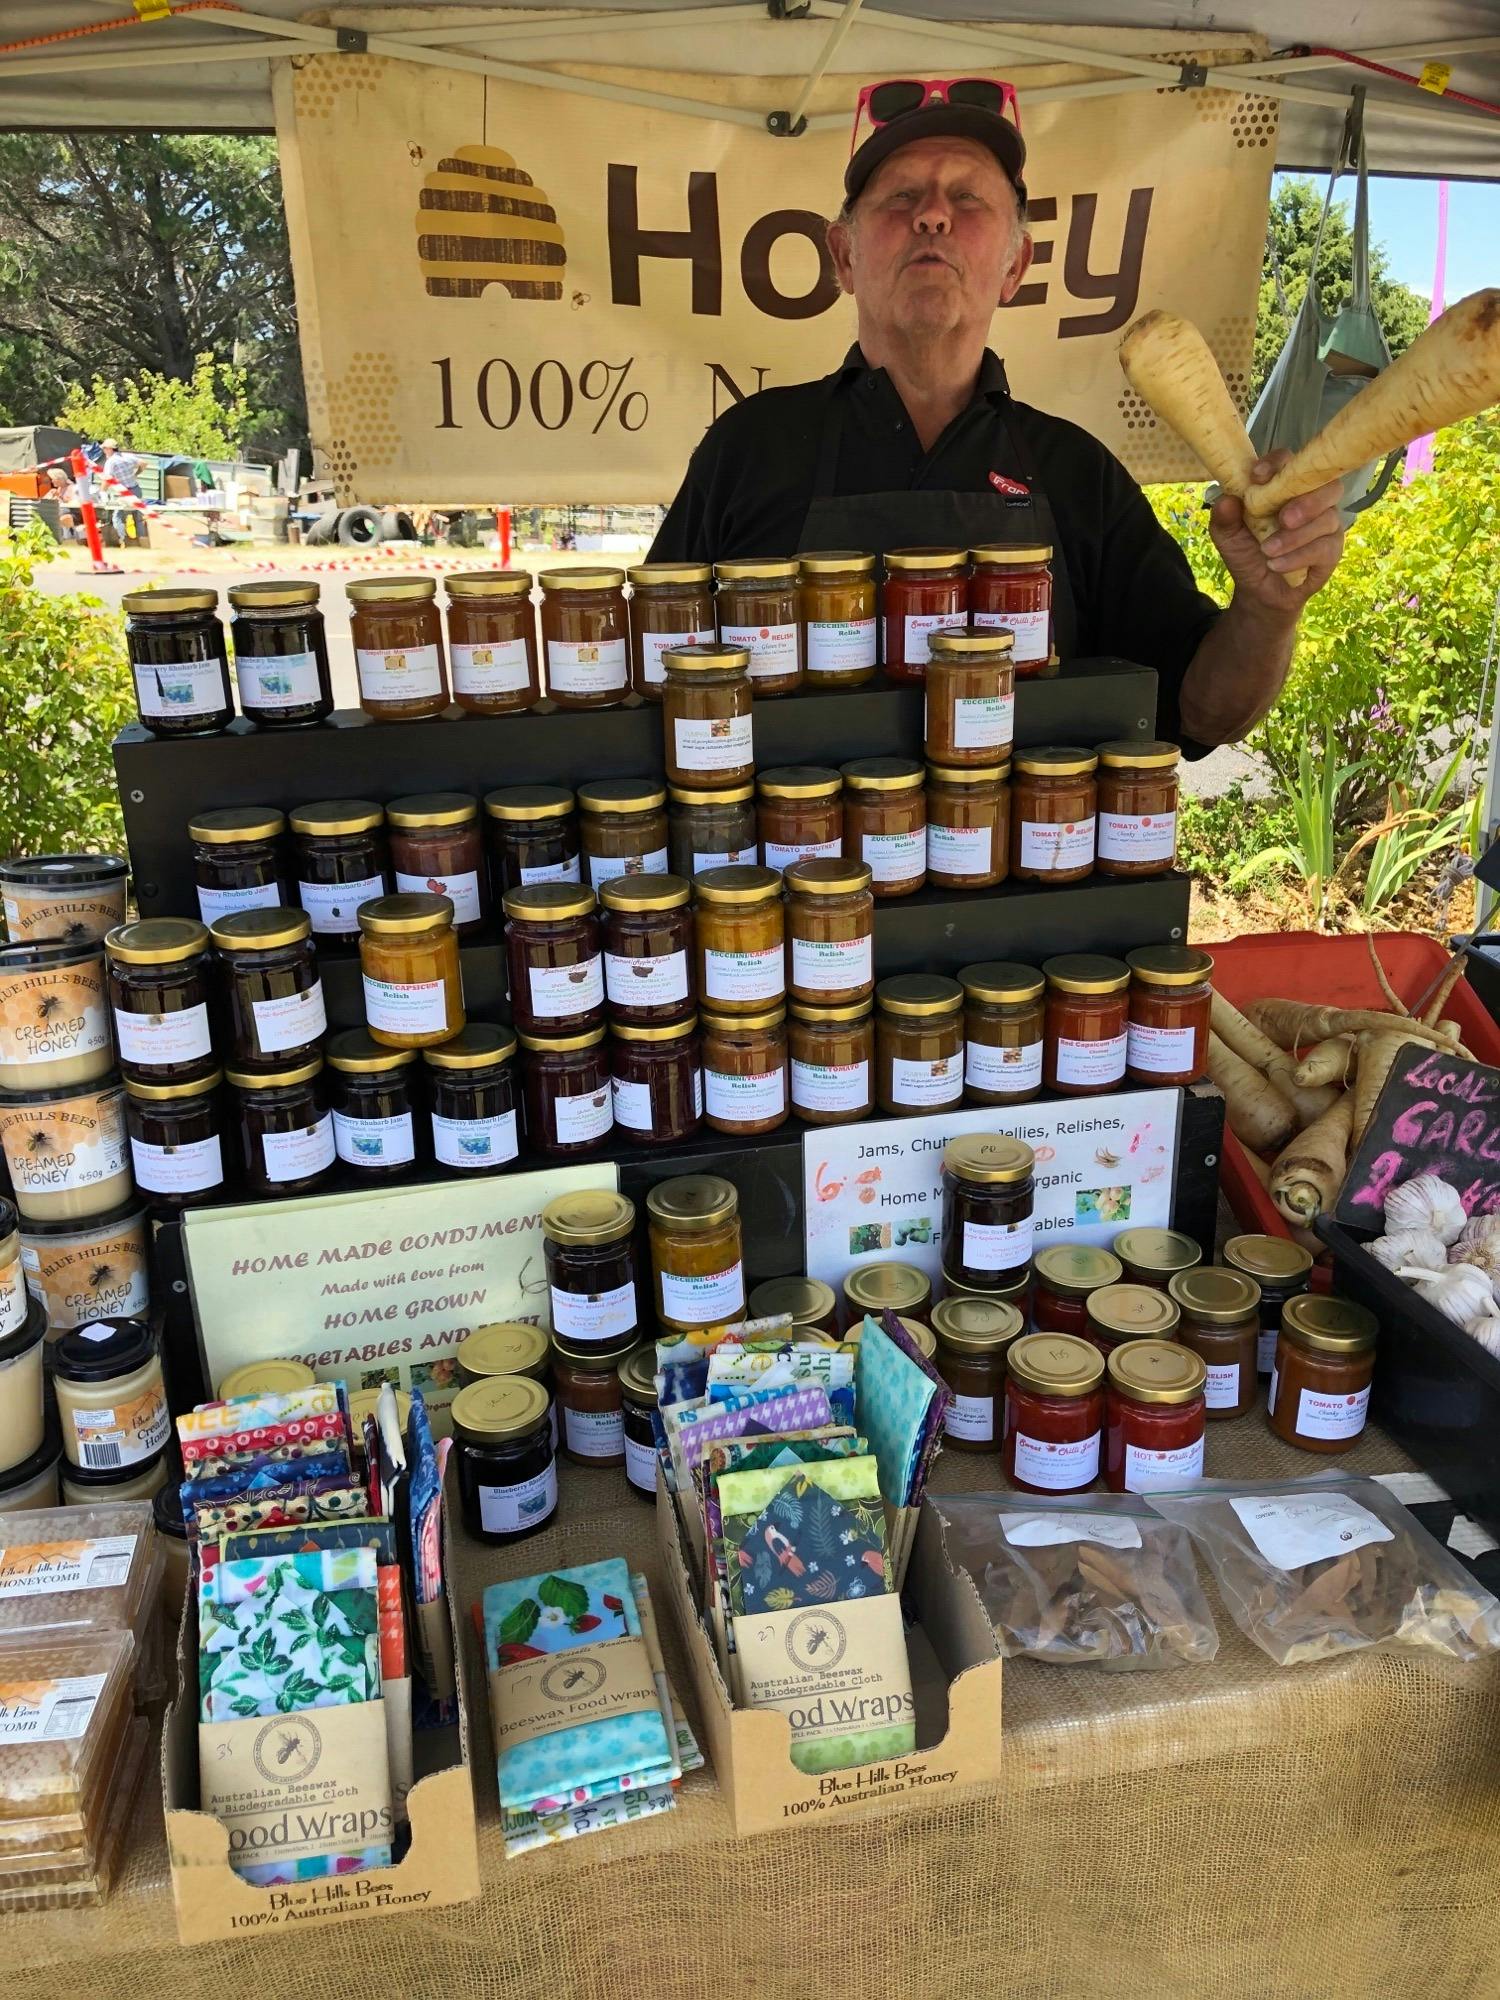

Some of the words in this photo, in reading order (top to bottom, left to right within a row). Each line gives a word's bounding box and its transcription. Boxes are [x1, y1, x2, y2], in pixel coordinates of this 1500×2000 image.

[430, 356, 650, 434] 100%
[911, 620, 933, 629] Sweet
[772, 633, 794, 641] RELISH
[1109, 822, 1138, 830] TOMATO
[1153, 820, 1174, 829] RELISH
[771, 845, 800, 853] TOMATO
[805, 843, 835, 852] CHUTNEY
[894, 840, 915, 849] Relish
[934, 833, 955, 841] Relish
[223, 889, 253, 898] Rhubarb
[254, 887, 269, 895] Jam
[331, 882, 361, 891] Rhubarb
[362, 879, 376, 887] Jam
[21, 908, 53, 929] BLUE
[55, 903, 97, 914] HILLS
[98, 903, 123, 923] BEES
[736, 959, 762, 967] Relish
[24, 974, 69, 990] HILLS
[72, 974, 101, 994] BEES
[383, 991, 409, 999] Relish
[15, 1016, 87, 1041] CREAMED
[27, 1032, 82, 1055] HONEY
[1060, 1039, 1074, 1047] Red
[1075, 1039, 1110, 1048] Capsicum
[812, 1072, 838, 1080] Relish
[15, 1111, 56, 1124] HILLS
[60, 1112, 97, 1130] BEES
[360, 1117, 388, 1126] Rhubarb
[388, 1117, 403, 1125] Jam
[468, 1115, 497, 1126] Rhubarb
[497, 1113, 508, 1122] Jam
[857, 1143, 905, 1159] Jams,
[1056, 1117, 1125, 1135] Relishes,
[1392, 1100, 1500, 1163] GARL
[13, 1152, 76, 1172] CREAMED
[23, 1168, 72, 1186] HONEY
[78, 1170, 103, 1182] 450g
[880, 1190, 925, 1207] Home
[1034, 1170, 1083, 1188] rganic
[42, 1253, 76, 1278] BLUE
[78, 1243, 121, 1260] HILLS
[231, 1252, 309, 1276] HOME
[316, 1239, 393, 1266] MADE
[320, 1280, 370, 1296] Made
[373, 1272, 406, 1288] with
[410, 1267, 444, 1282] love
[448, 1262, 485, 1279] from
[692, 1282, 719, 1290] Relish
[64, 1281, 133, 1308] CREAMED
[75, 1300, 127, 1322] HONEY
[324, 1304, 398, 1330] HOME
[405, 1288, 487, 1320] GROWN
[420, 1327, 472, 1350] AND
[1308, 1398, 1343, 1410] TOMATO
[138, 1414, 168, 1440] Cream
[1019, 1438, 1042, 1453] Sweet
[1058, 1446, 1080, 1457] Chilli
[1133, 1451, 1153, 1462] HOT
[1168, 1450, 1189, 1463] Chilli
[493, 1483, 528, 1494] Blueberry
[56, 1560, 82, 1571] Bees
[750, 1674, 814, 1690] Australian
[819, 1666, 863, 1681] Beeswax
[764, 1680, 846, 1699] Biodegradable
[851, 1673, 883, 1686] Cloth
[13, 1704, 40, 1718] Bees
[499, 1707, 566, 1737] Beeswax
[569, 1694, 608, 1713] Food
[610, 1688, 659, 1702] Wraps
[789, 1697, 824, 1729] od
[829, 1690, 915, 1723] Wraps
[818, 1778, 852, 1796] Blue
[857, 1769, 890, 1791] Hills
[894, 1762, 928, 1779] Bees
[210, 1787, 282, 1805] Australian
[287, 1778, 338, 1795] Beeswax
[225, 1792, 317, 1815] Biodegradable
[322, 1786, 359, 1801] Cloth
[782, 1798, 826, 1818] 100%
[829, 1782, 905, 1808] Australian
[909, 1770, 958, 1789] Honey
[229, 1813, 289, 1850] ood
[297, 1805, 393, 1840] Wraps
[270, 1892, 308, 1911] Blue
[312, 1884, 351, 1904] Hills
[356, 1879, 394, 1897] Bees
[230, 1909, 279, 1929] 100%
[285, 1898, 370, 1923] Australian
[376, 1889, 433, 1906] Honey
